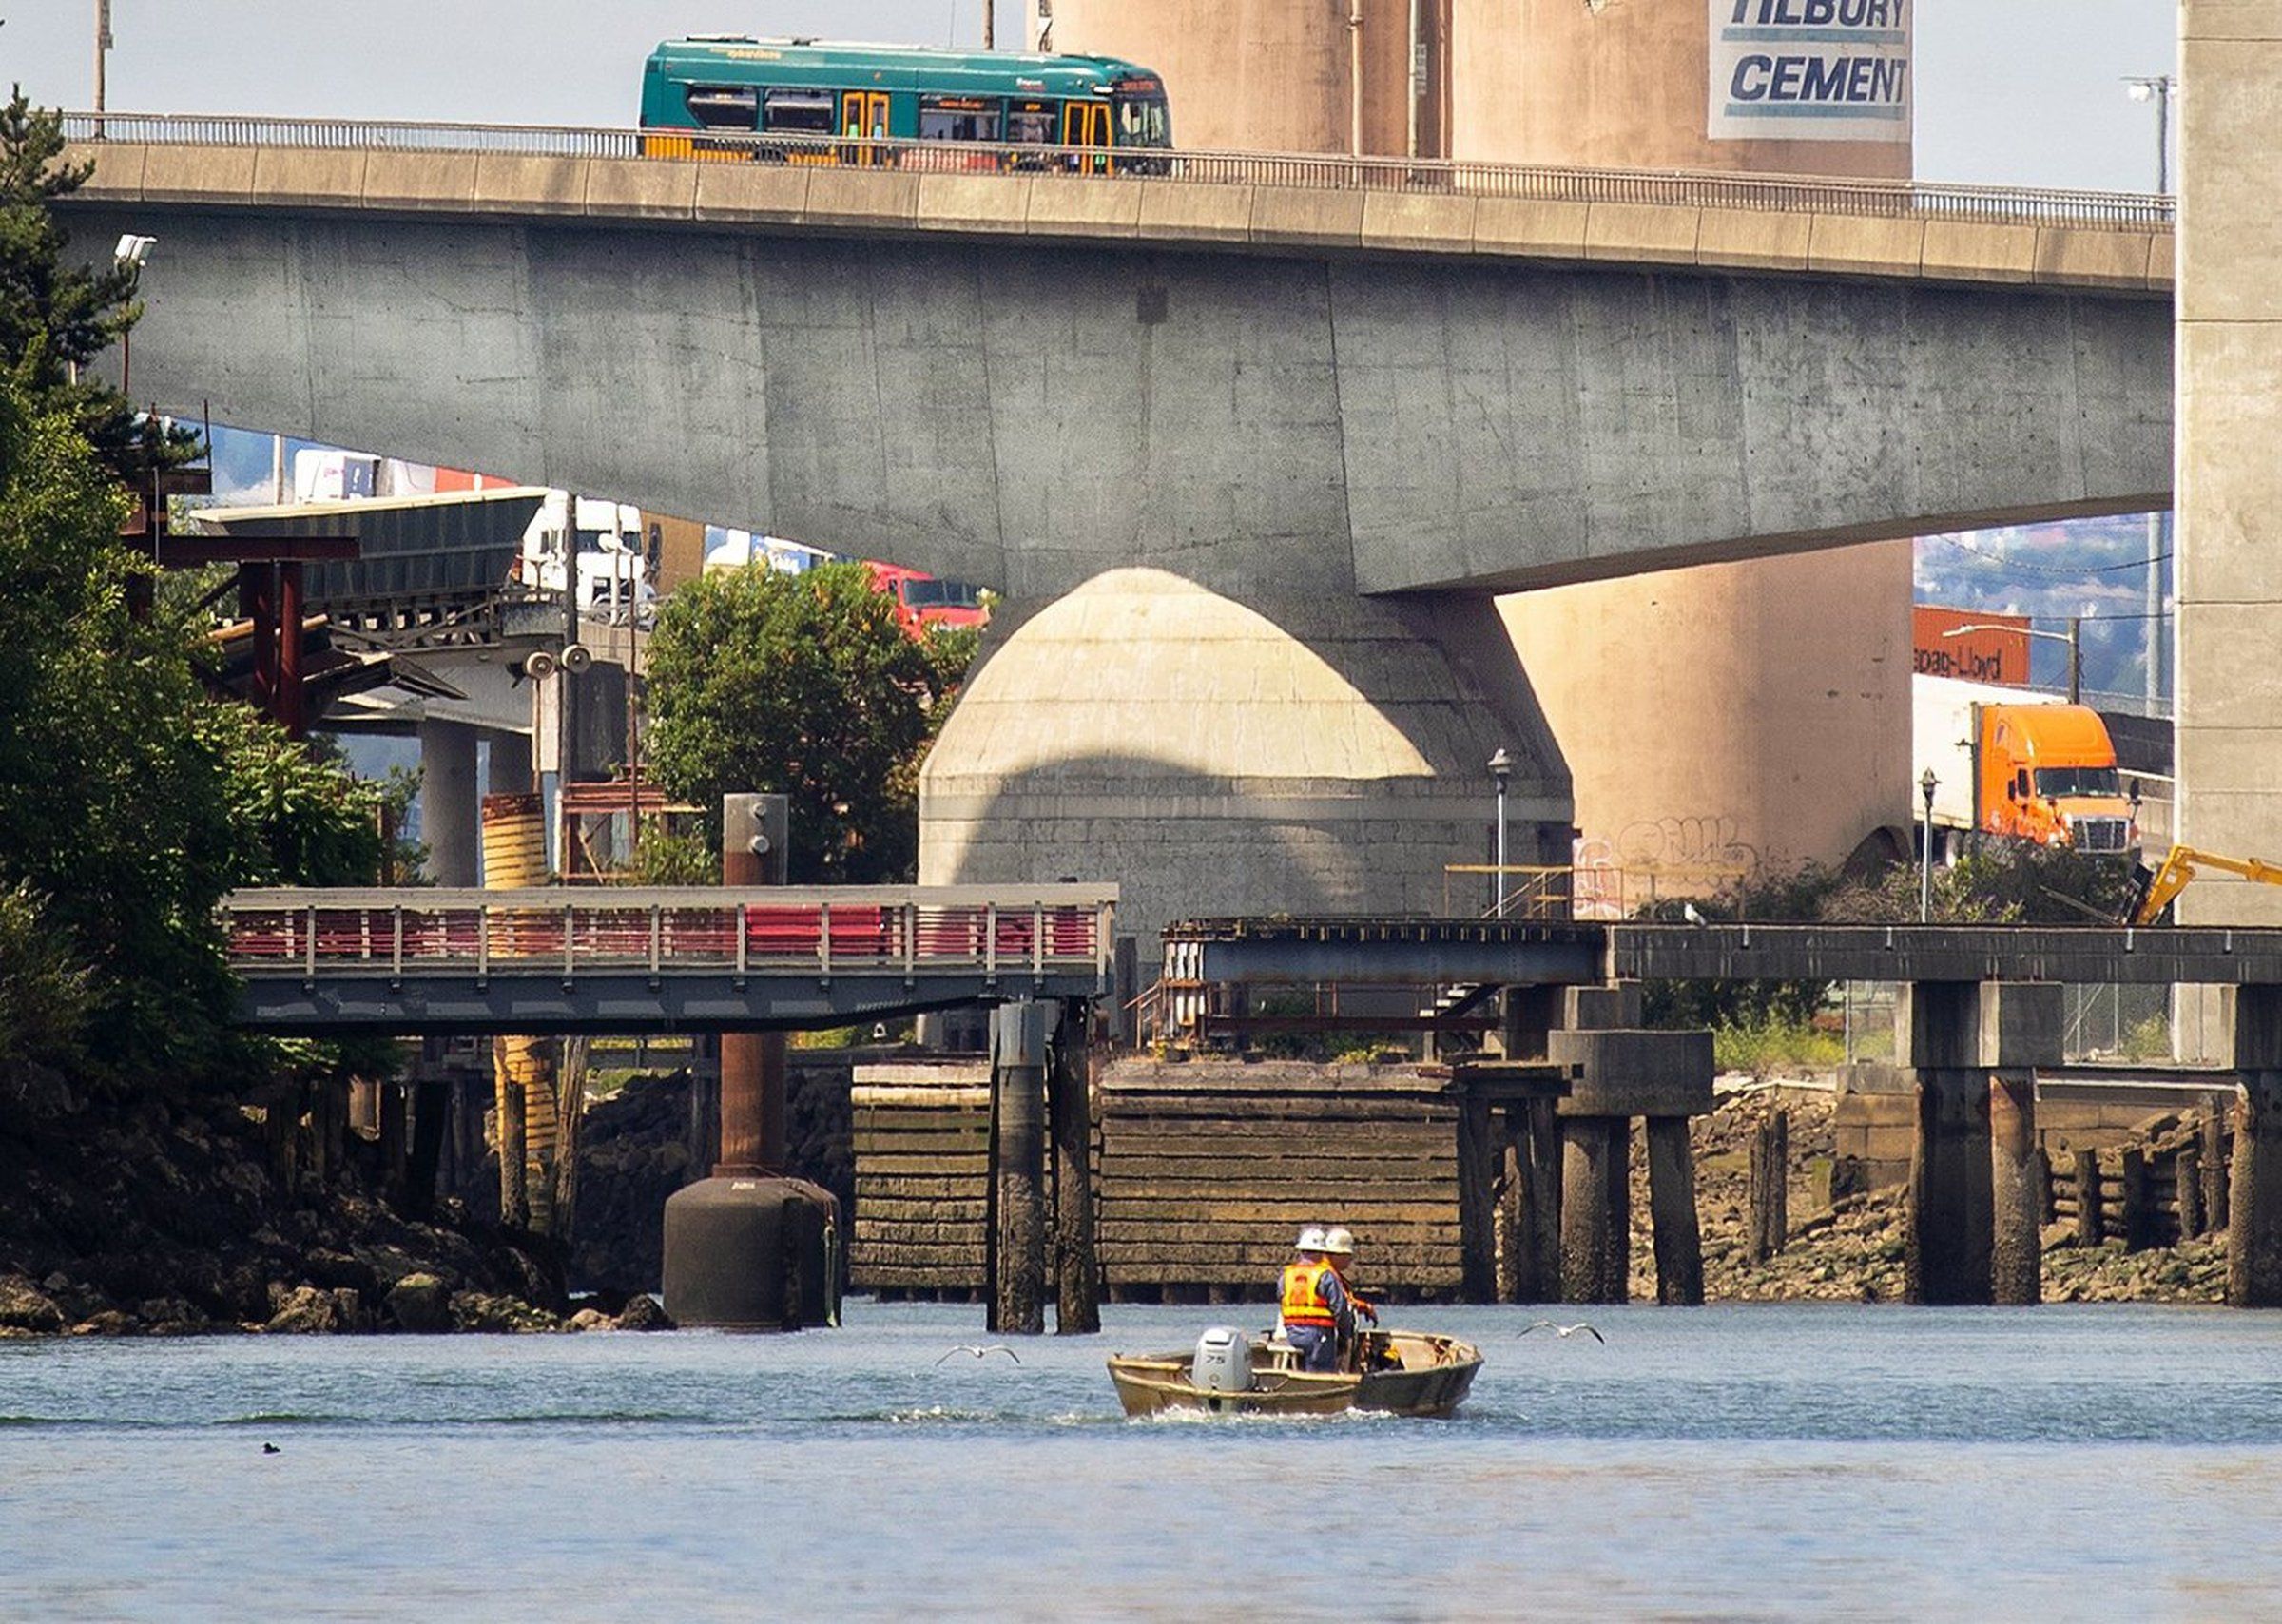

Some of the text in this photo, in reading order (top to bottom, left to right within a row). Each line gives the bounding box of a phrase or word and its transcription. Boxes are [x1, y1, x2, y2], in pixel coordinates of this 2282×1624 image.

[1731, 54, 1907, 103] CEMENT
[1913, 646, 2002, 682] apag-Lloyd
[1207, 1354, 1226, 1364] 75
